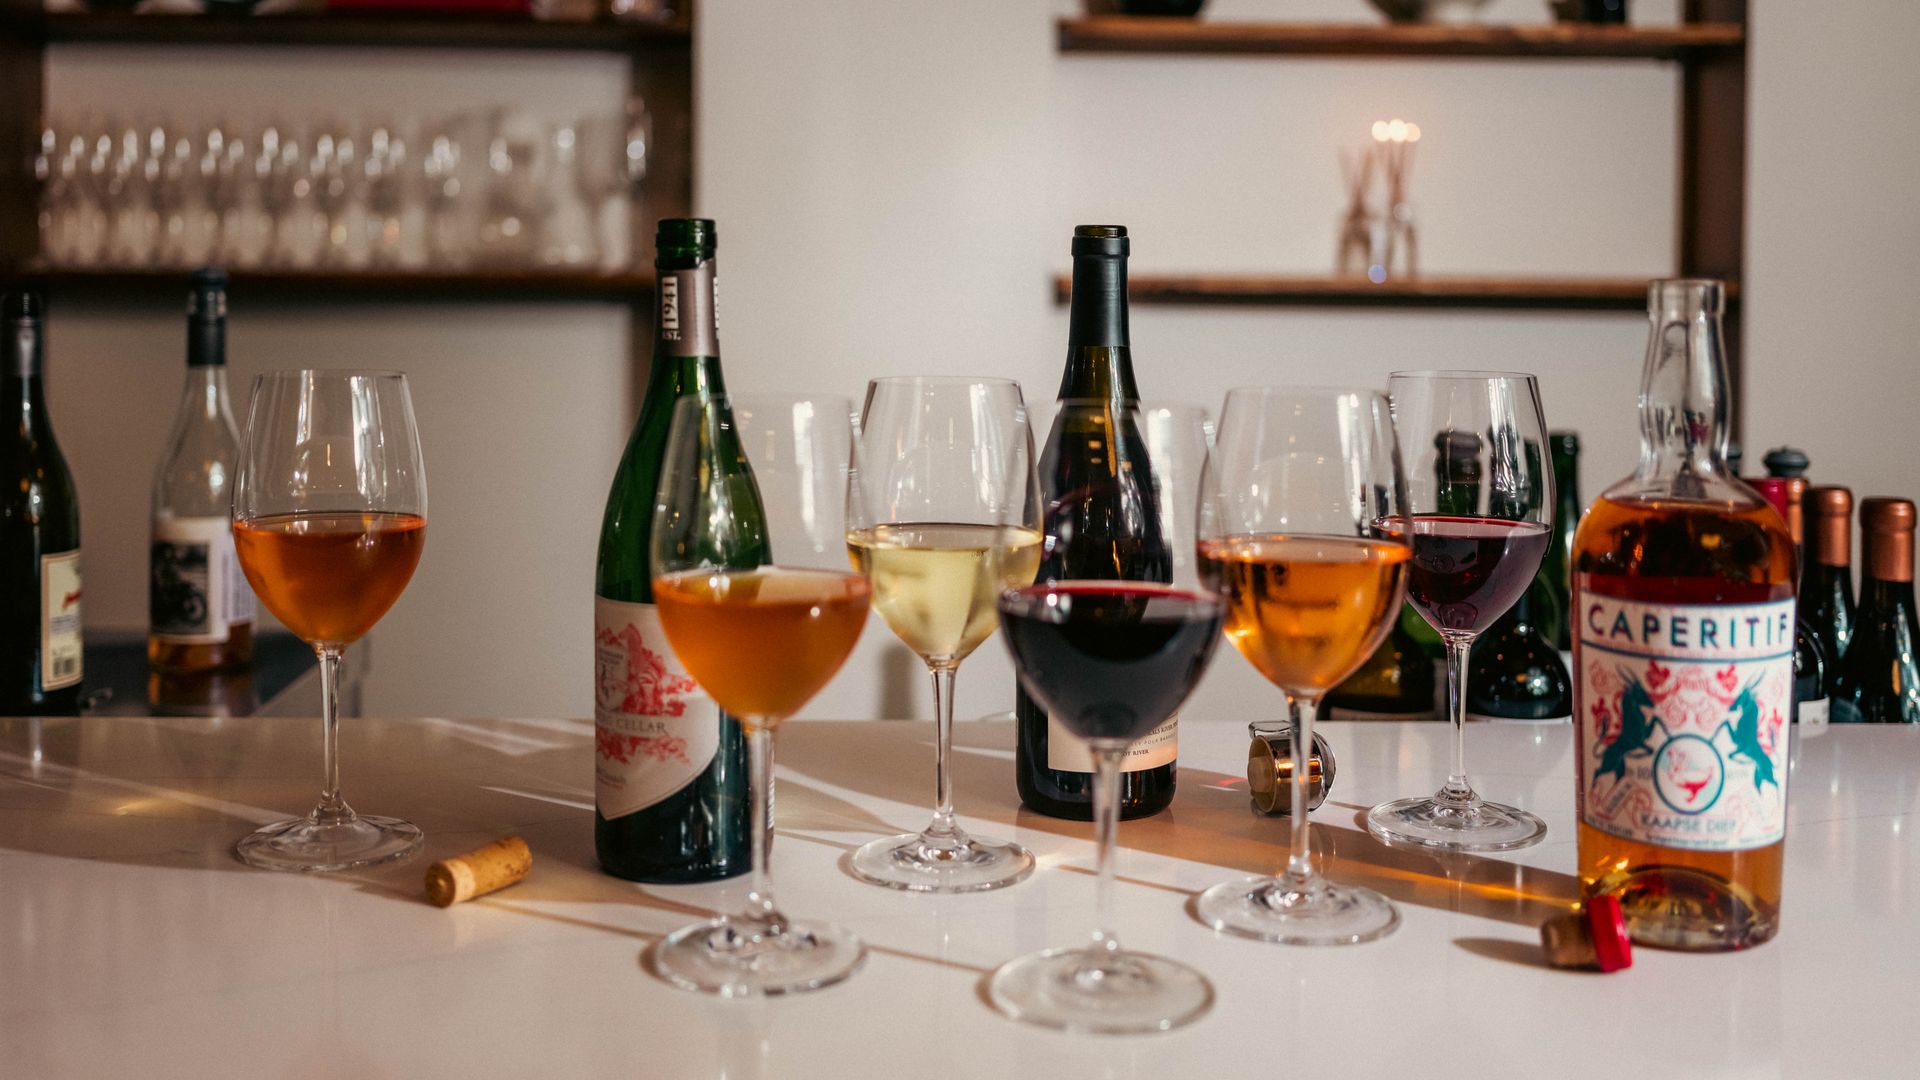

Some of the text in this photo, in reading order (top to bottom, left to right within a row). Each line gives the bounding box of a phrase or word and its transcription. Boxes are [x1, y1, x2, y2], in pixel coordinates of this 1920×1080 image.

[663, 282, 676, 323] 1941
[1588, 602, 1788, 649] CAPERITIF
[616, 718, 669, 736] CELLAR
[1640, 814, 1700, 832] KAAPSE
